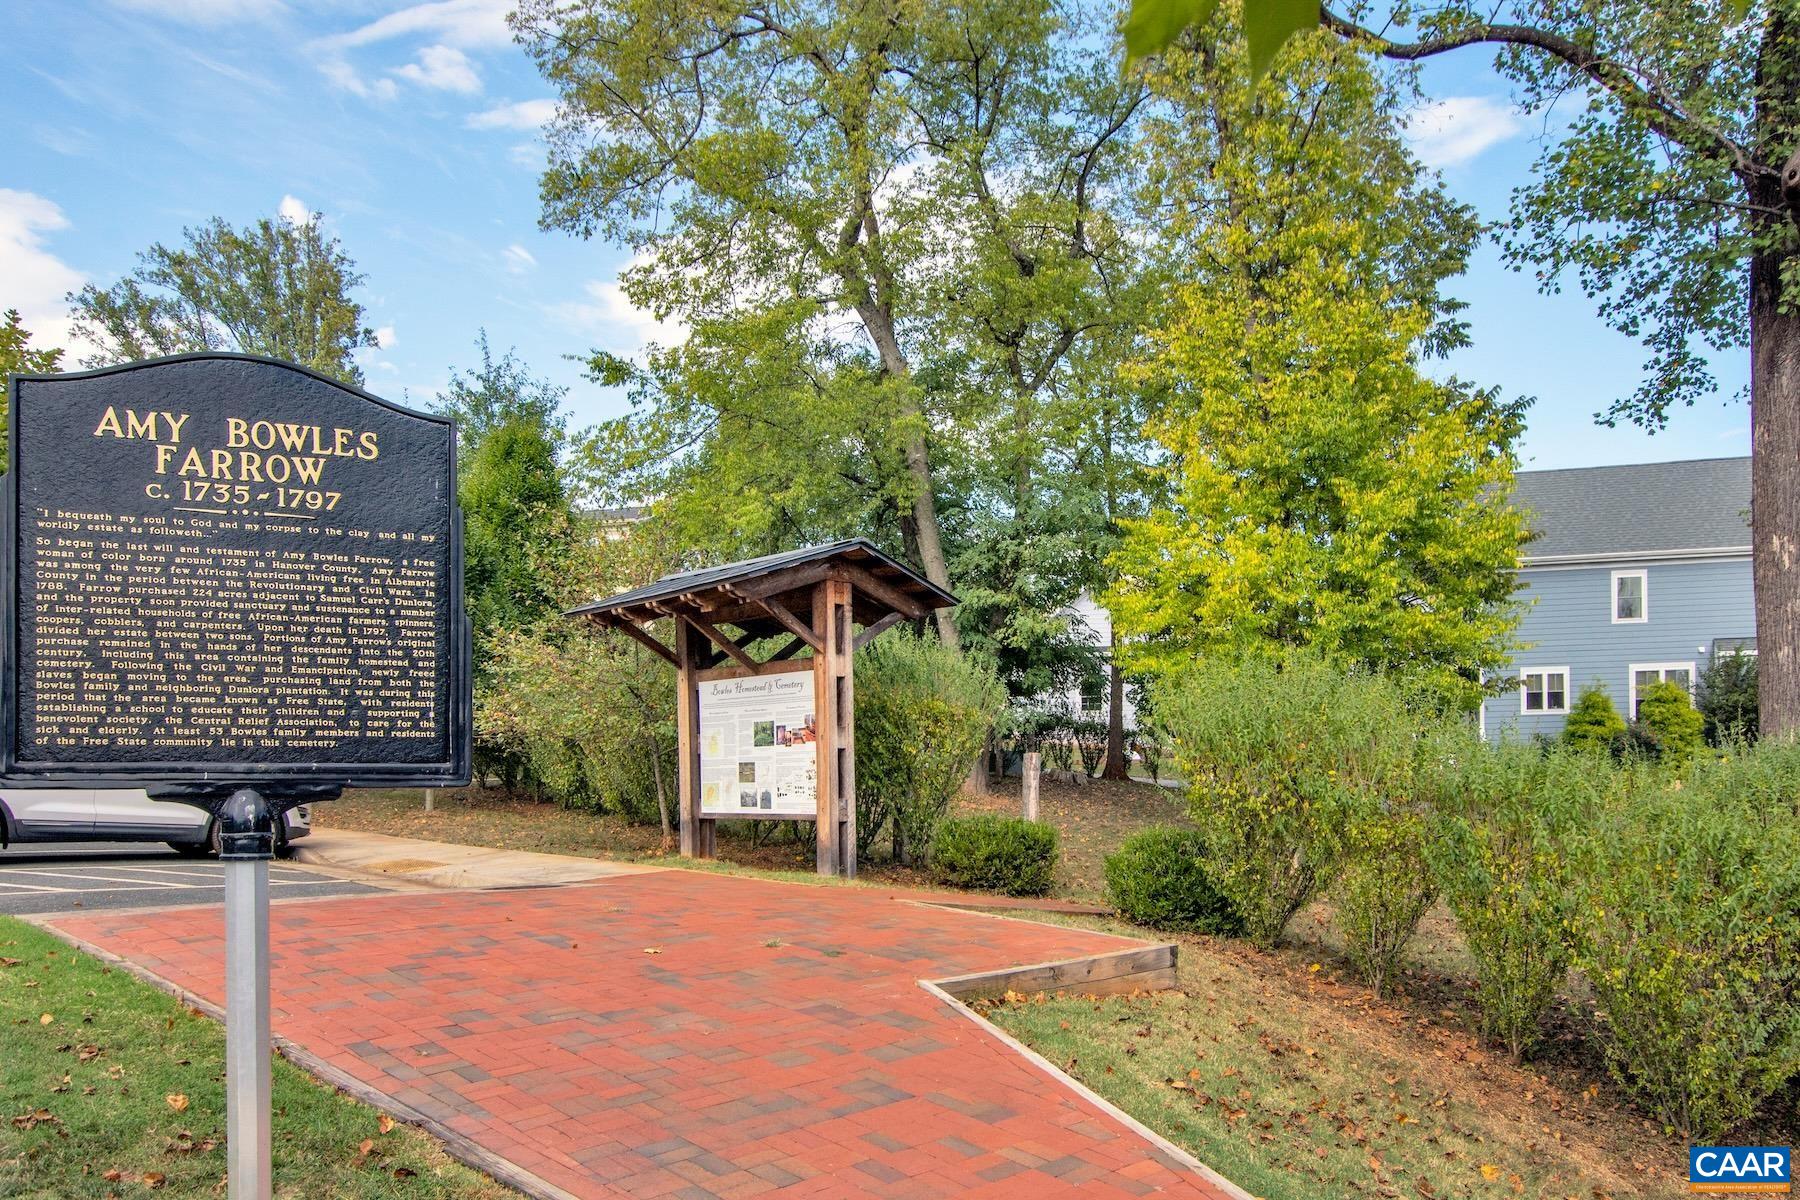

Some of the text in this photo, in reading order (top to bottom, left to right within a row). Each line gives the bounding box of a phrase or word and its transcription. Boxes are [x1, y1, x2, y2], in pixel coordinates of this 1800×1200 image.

[93, 405, 380, 460] AMY BOWLES
[155, 444, 327, 486] FARROW
[145, 483, 170, 499] c.
[36, 520, 80, 531] worldly
[87, 523, 123, 532] estate
[56, 509, 112, 522] bequeath
[119, 515, 136, 524] my
[143, 516, 165, 525] soul
[172, 517, 184, 526] to
[190, 518, 212, 527] God
[218, 521, 238, 529] and
[244, 523, 260, 531] my
[265, 524, 301, 533] corpse
[307, 526, 319, 534] to
[324, 527, 342, 536] the
[348, 529, 369, 539] clay
[378, 531, 396, 539] and
[402, 532, 414, 541] all
[421, 534, 435, 542] my
[36, 536, 50, 545] So
[57, 537, 93, 550] began
[100, 540, 119, 549] the
[126, 541, 148, 552] last
[153, 543, 173, 552] will
[179, 546, 199, 554] and
[205, 546, 259, 557] testament
[264, 549, 276, 558] of
[282, 551, 305, 561] Amy
[312, 552, 348, 562] Bowles
[413, 558, 435, 567] free
[36, 549, 74, 558] woman
[80, 550, 93, 559] of
[101, 551, 131, 561] color
[138, 553, 165, 562] born
[174, 556, 212, 565] around
[221, 558, 246, 566] 1735
[254, 560, 265, 568] in
[271, 560, 316, 570] Hanover
[371, 567, 393, 576] Amy
[400, 567, 435, 577] Farrow
[35, 559, 58, 568] was
[63, 562, 101, 571] among
[109, 562, 128, 571] the
[134, 565, 161, 574] very
[169, 565, 190, 575] few
[307, 573, 336, 583] living
[342, 575, 364, 583] free
[370, 576, 380, 584] in
[384, 577, 435, 587] Albemarle
[36, 570, 78, 581] County
[85, 572, 96, 580] in
[103, 573, 122, 582] the
[128, 575, 167, 584] period
[172, 576, 219, 586] between
[225, 579, 243, 588] the
[249, 580, 324, 593] Revolutionary
[332, 585, 350, 593] and
[358, 586, 382, 595] Civil
[424, 589, 435, 597] In
[35, 592, 57, 601] and
[64, 593, 84, 602] the
[90, 595, 142, 605] property
[149, 598, 175, 606] soon
[180, 599, 228, 608] provided
[233, 602, 286, 611] sanctuary
[315, 605, 370, 614] sustenance
[400, 608, 435, 617] number
[35, 603, 48, 612] of
[137, 607, 196, 617] households
[201, 610, 213, 618] of
[217, 611, 240, 619] free
[35, 625, 79, 635] divided
[86, 627, 106, 635] her
[113, 629, 148, 638] estate
[154, 629, 199, 639] between
[263, 633, 305, 642] Portions
[310, 635, 322, 643] of
[325, 636, 347, 645] Amy
[396, 639, 435, 648] original
[36, 637, 435, 657] purchase remained in the hands of her descendants into the 20th
[35, 680, 75, 689] Bowles
[83, 681, 120, 691] family
[127, 683, 147, 691] and
[155, 683, 221, 694] neighboring
[228, 685, 269, 694] Dunlora
[378, 689, 410, 699] during
[417, 690, 435, 698] this
[734, 680, 768, 694] Homestead
[774, 678, 804, 694] Cemetery
[35, 725, 60, 733] sick
[68, 726, 88, 734] and
[153, 726, 165, 734] At
[173, 726, 200, 735] least
[208, 727, 223, 735] 53
[230, 727, 267, 736] Bowles
[273, 727, 306, 737] family
[315, 728, 359, 736] members
[366, 729, 383, 737] and
[35, 736, 48, 744] of
[56, 736, 75, 745] the
[82, 736, 108, 745] Free
[116, 737, 146, 745] State
[152, 738, 213, 747] community
[221, 738, 235, 746] lie
[242, 738, 253, 746] in
[260, 738, 279, 747] this
